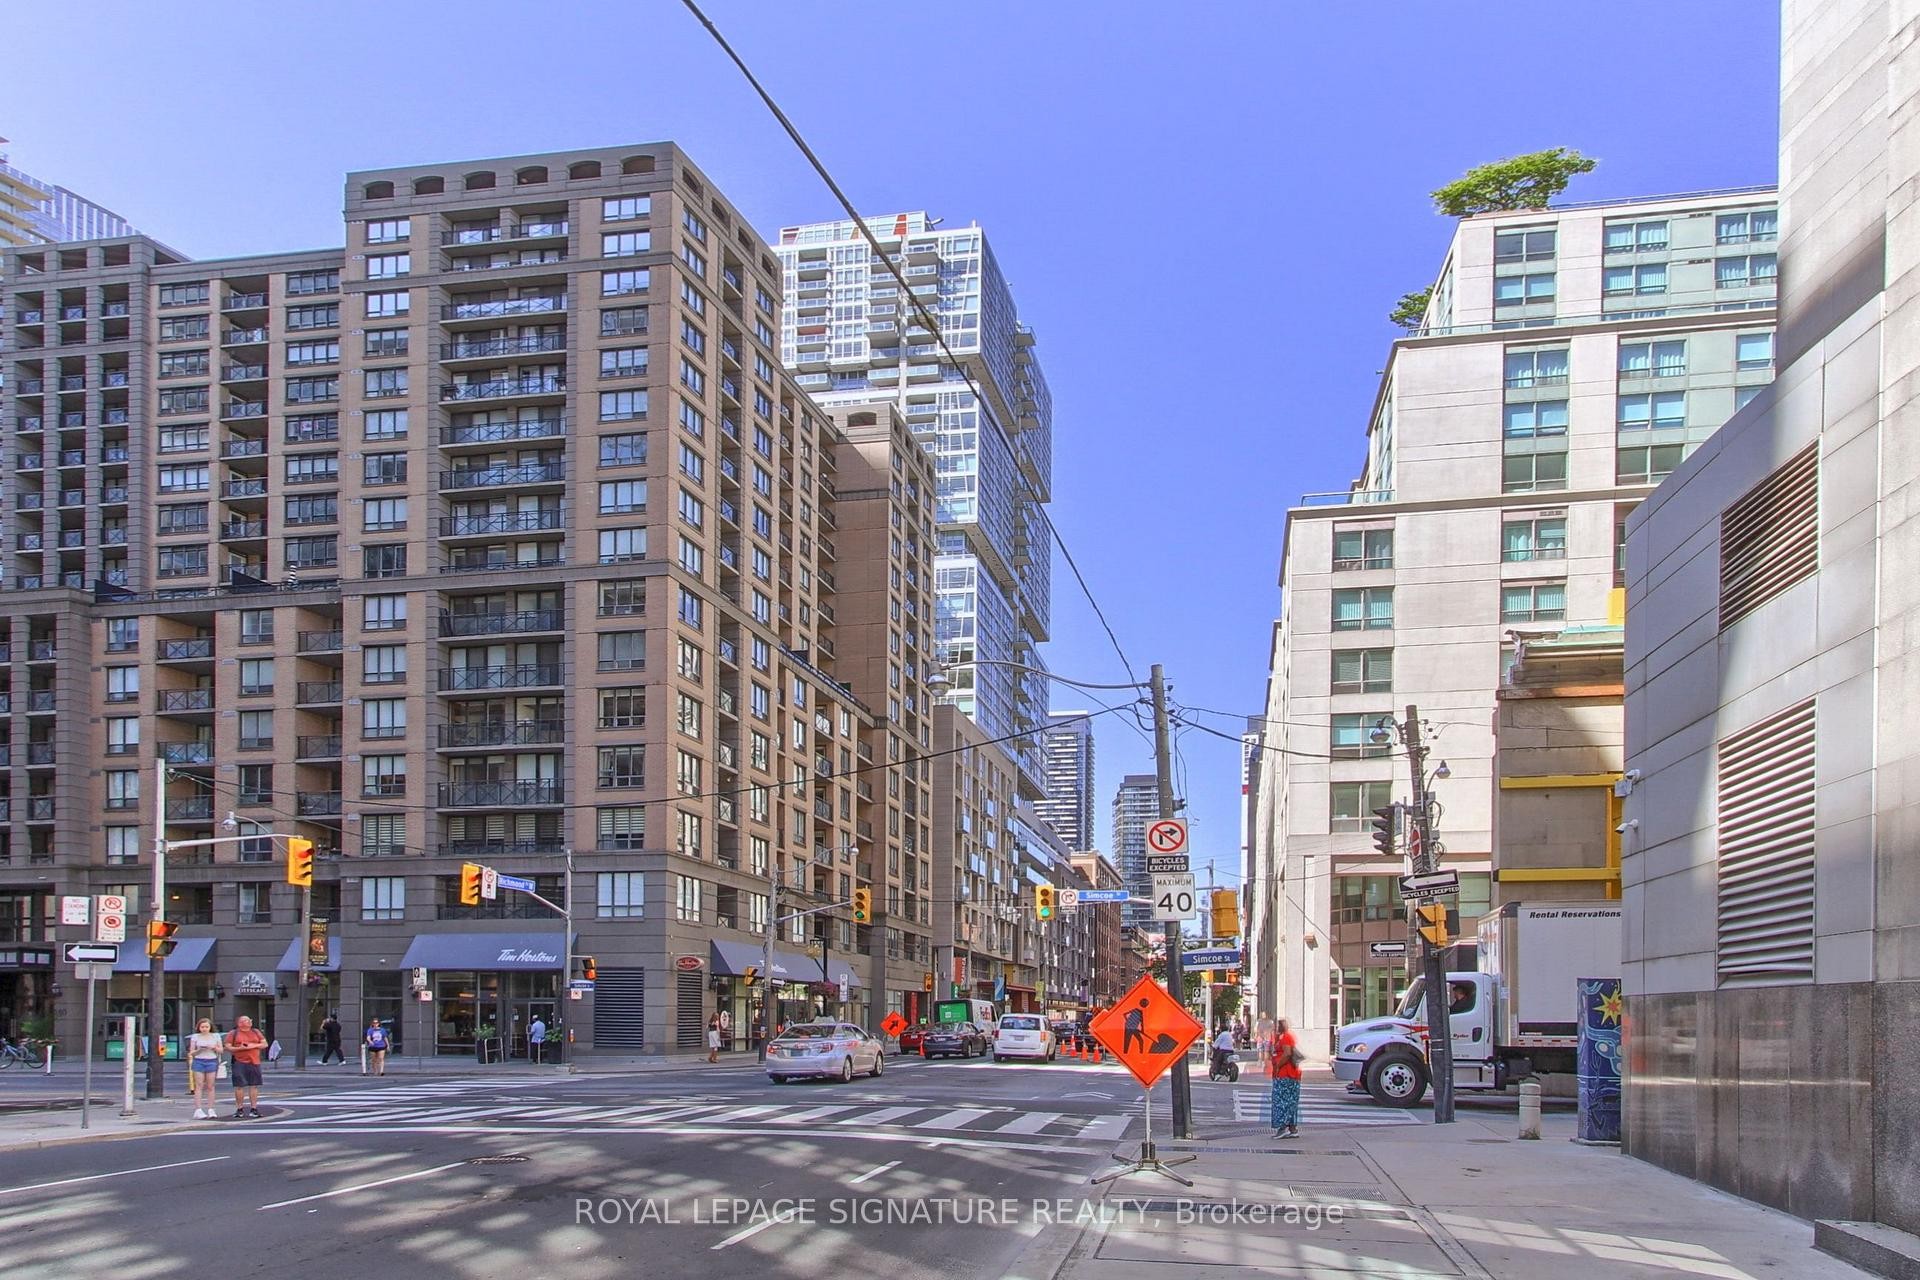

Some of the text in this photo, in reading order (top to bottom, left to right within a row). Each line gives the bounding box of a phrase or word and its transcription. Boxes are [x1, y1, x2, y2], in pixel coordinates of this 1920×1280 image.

[1430, 886, 1460, 896] EXCEPTED
[1157, 892, 1192, 913] 40
[1529, 910, 1622, 919] Rental Reservations
[497, 948, 557, 963] Tim Hortons
[1193, 955, 1223, 964] Simcoe
